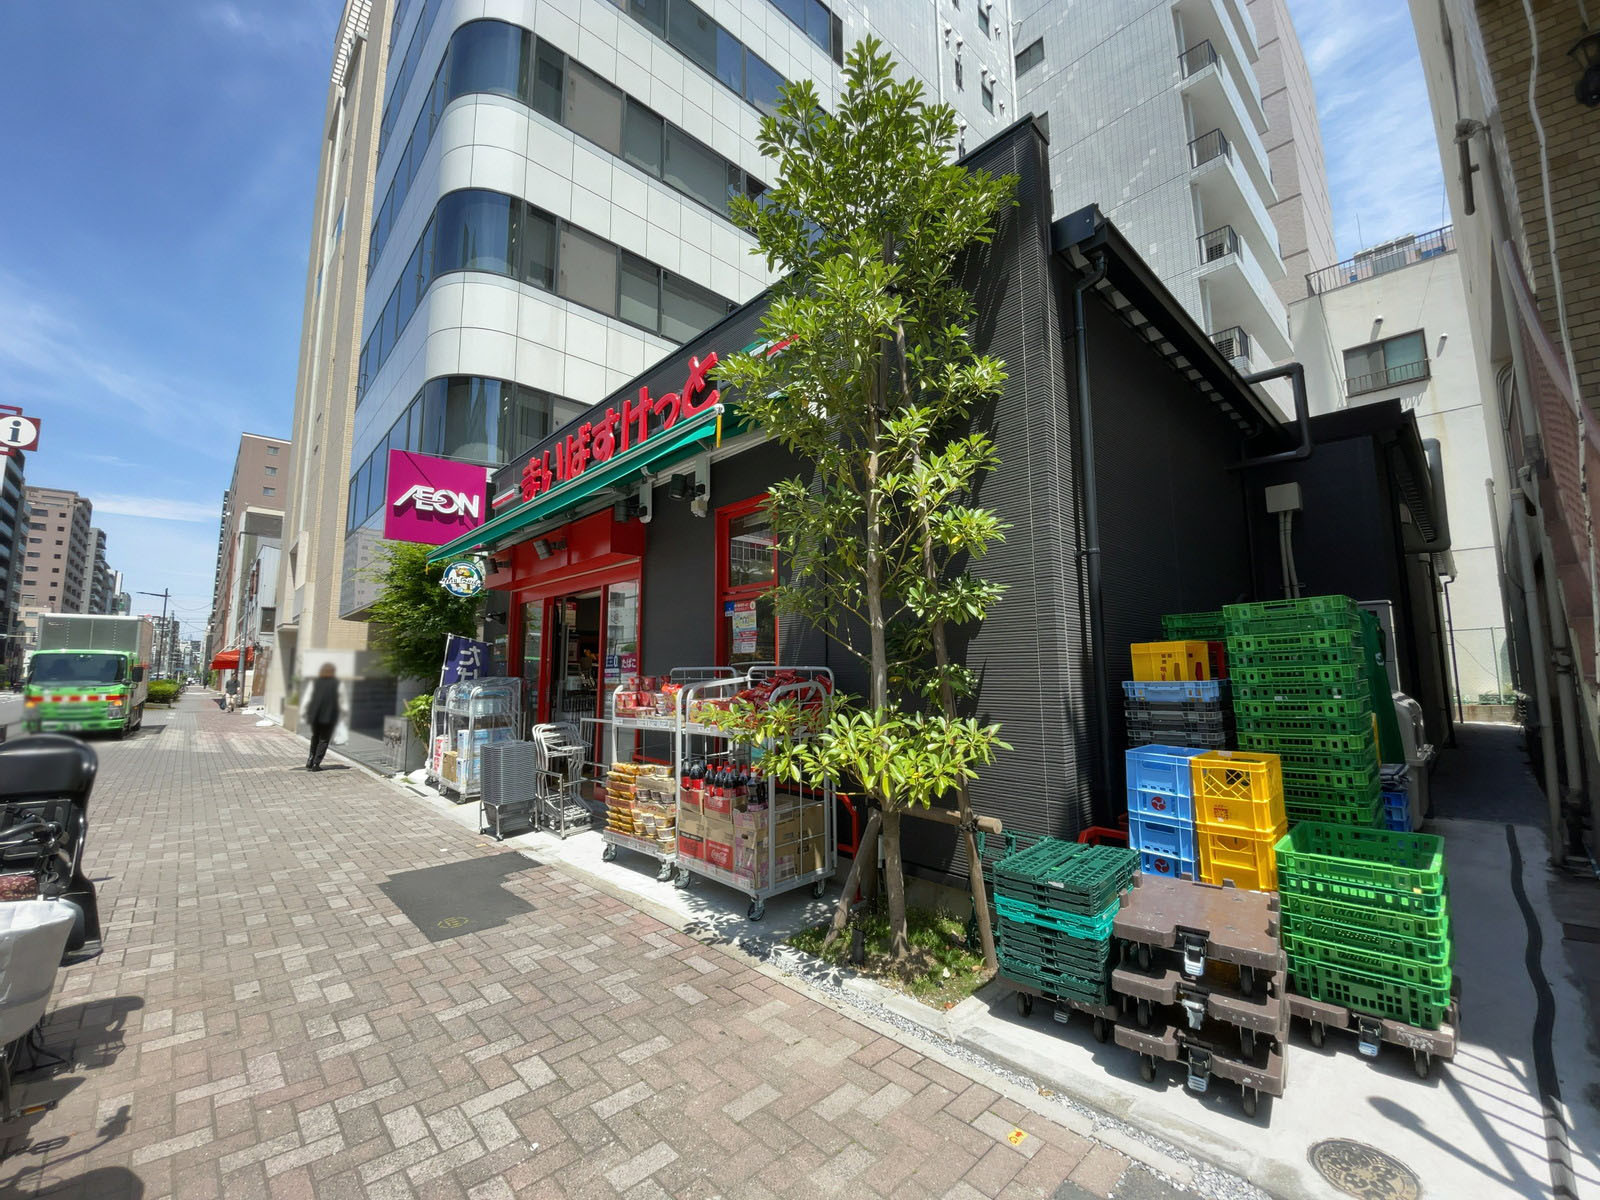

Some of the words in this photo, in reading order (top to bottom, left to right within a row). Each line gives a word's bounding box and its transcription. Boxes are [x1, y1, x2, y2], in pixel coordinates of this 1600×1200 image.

[520, 351, 720, 503] まいばすけっと
[393, 484, 480, 518] AEON
[621, 657, 637, 669] たばこ
